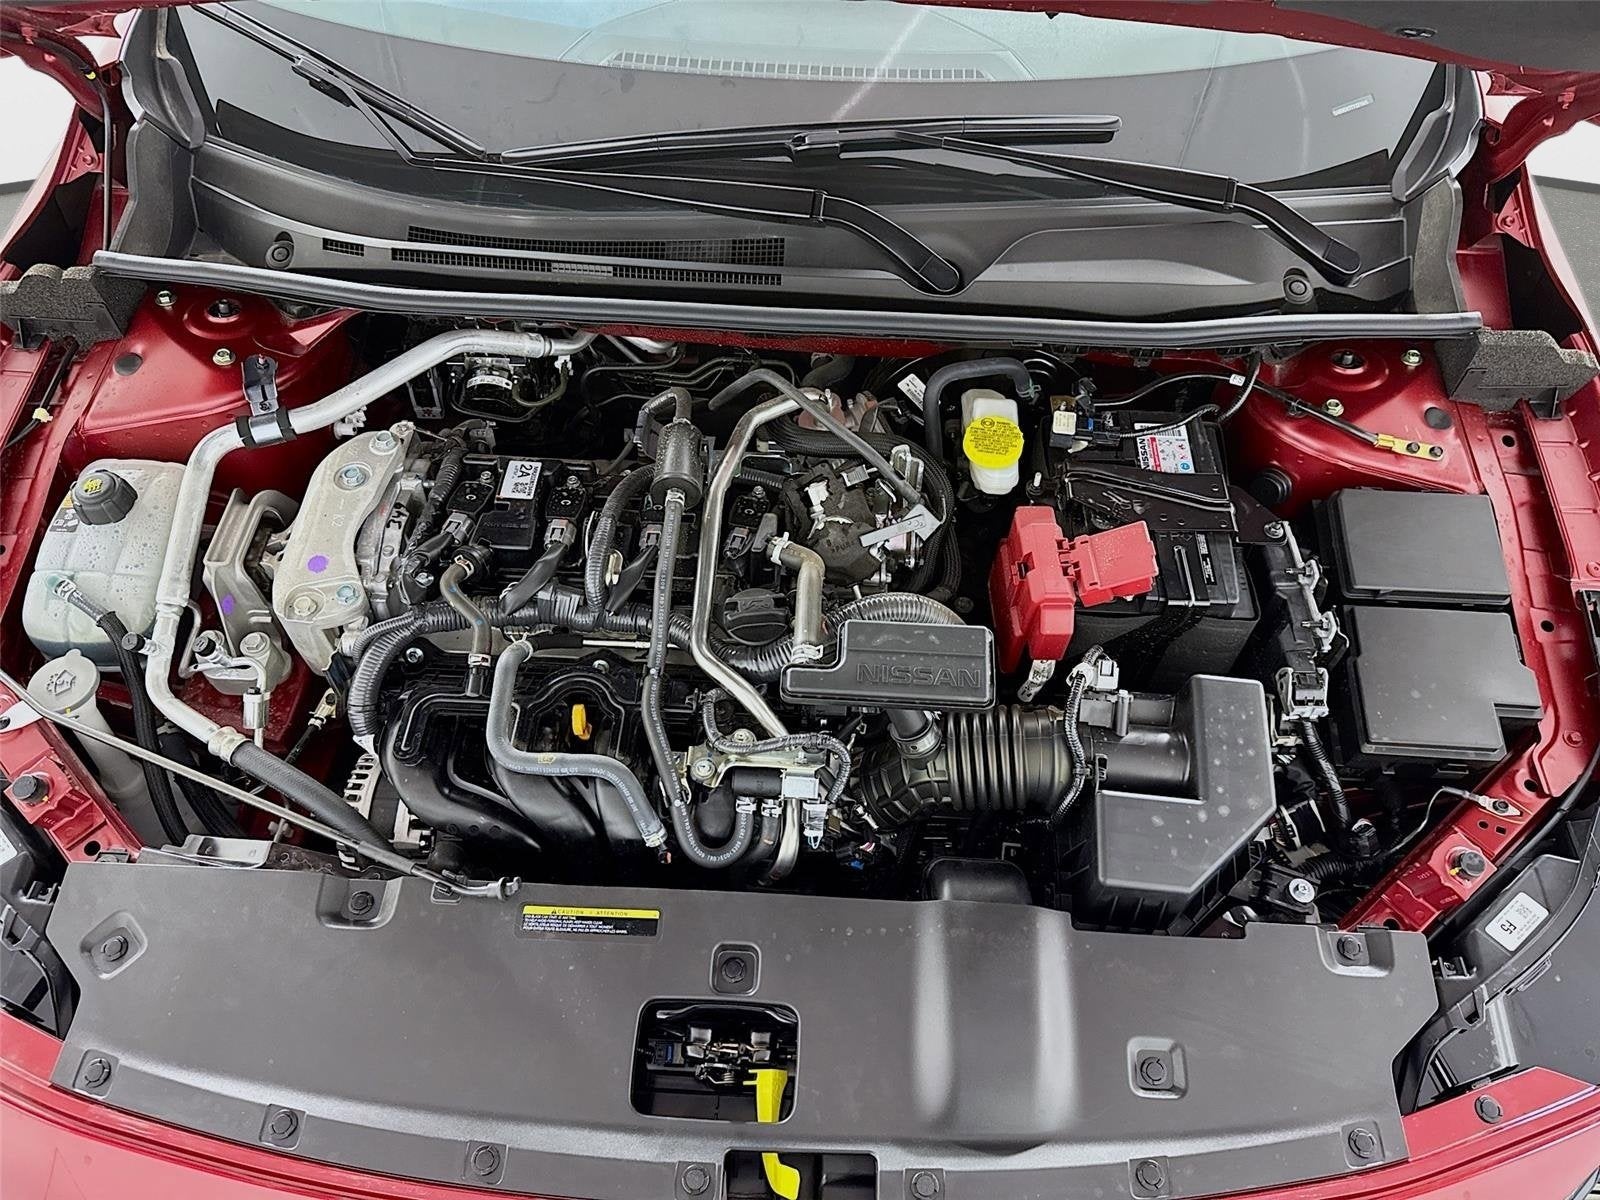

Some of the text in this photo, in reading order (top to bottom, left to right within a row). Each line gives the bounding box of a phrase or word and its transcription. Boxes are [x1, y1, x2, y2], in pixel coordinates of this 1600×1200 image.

[1138, 438, 1150, 471] NISSAN
[517, 464, 533, 478] 2A
[856, 663, 981, 688] NISSAN
[1500, 919, 1517, 934] F5
